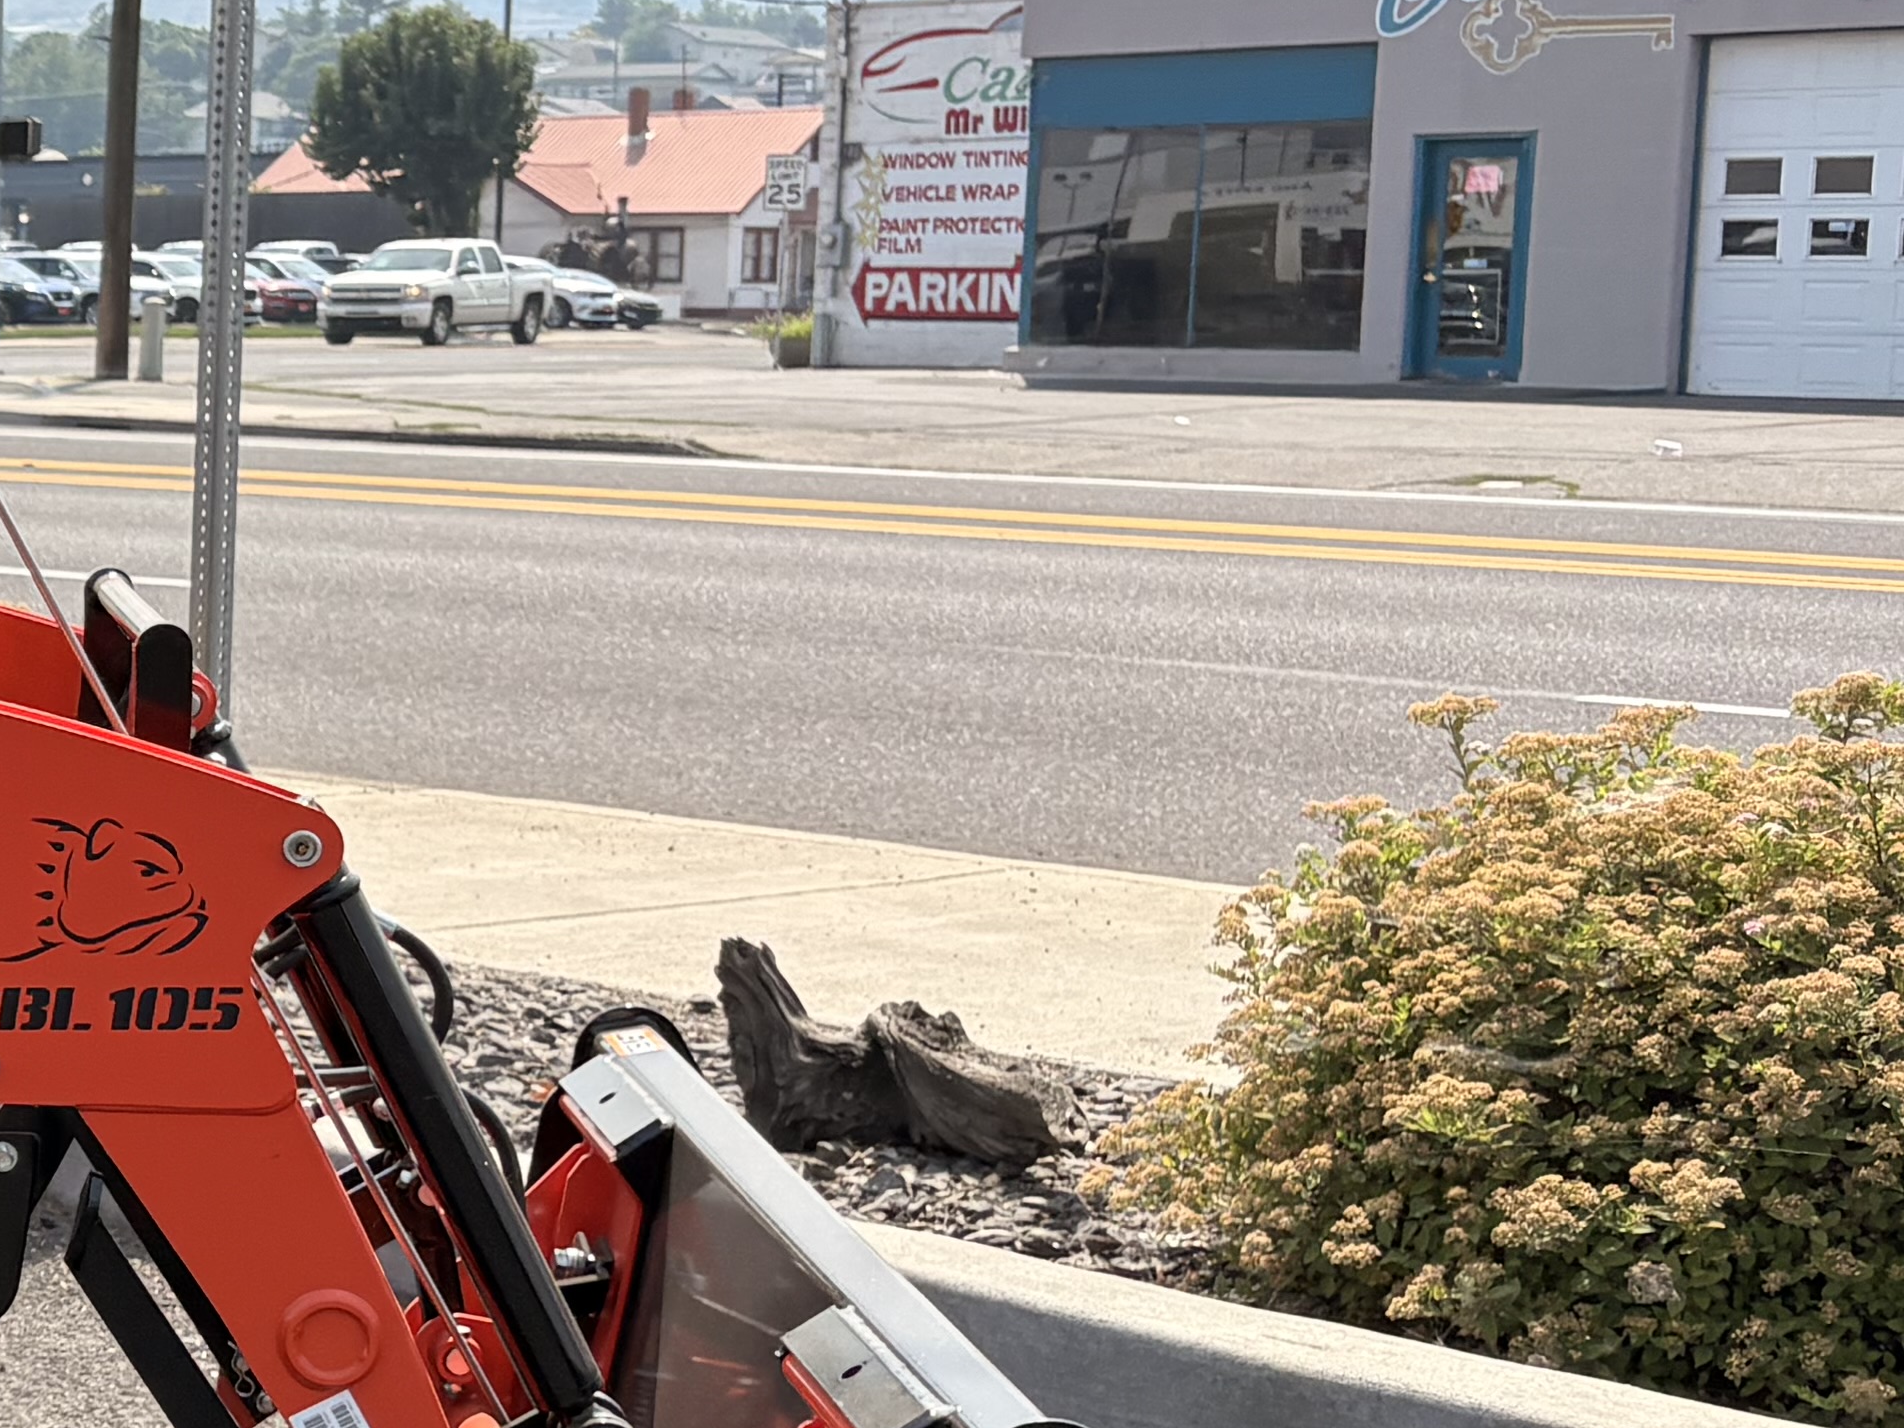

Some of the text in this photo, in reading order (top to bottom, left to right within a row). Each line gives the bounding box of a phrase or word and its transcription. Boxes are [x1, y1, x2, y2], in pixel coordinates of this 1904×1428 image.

[945, 107, 984, 135] Mr
[882, 151, 956, 170] WINDOW
[768, 183, 801, 205] 25
[882, 183, 1020, 203] VEHICLE WRAP
[878, 218, 930, 235] PAINT
[876, 237, 922, 254] FILM
[109, 987, 244, 1031] 105
